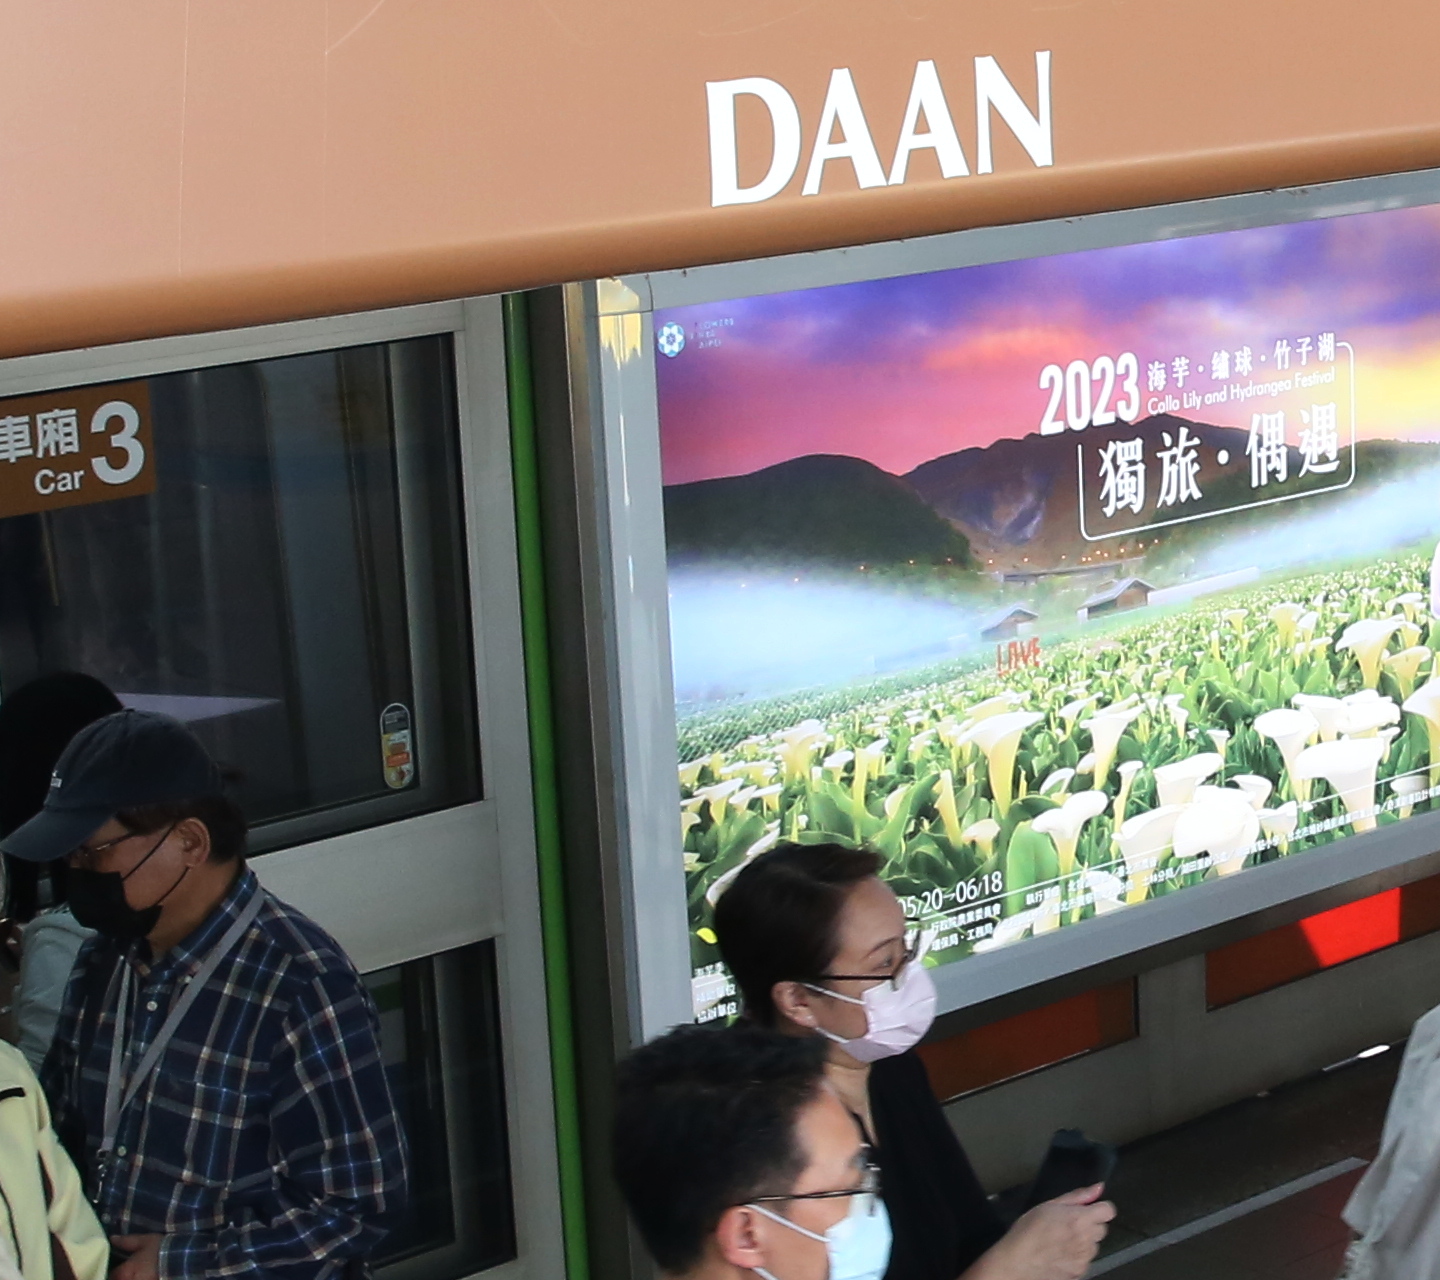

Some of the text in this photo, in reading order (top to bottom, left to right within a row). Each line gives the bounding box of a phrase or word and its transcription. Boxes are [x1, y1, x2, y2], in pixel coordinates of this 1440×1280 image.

[705, 50, 1054, 208] DAAN
[1039, 352, 1140, 436] 2023
[1147, 366, 1336, 415] Calla Lily and Hydrangea Festival
[34, 469, 85, 495] Car
[91, 400, 145, 484] 3
